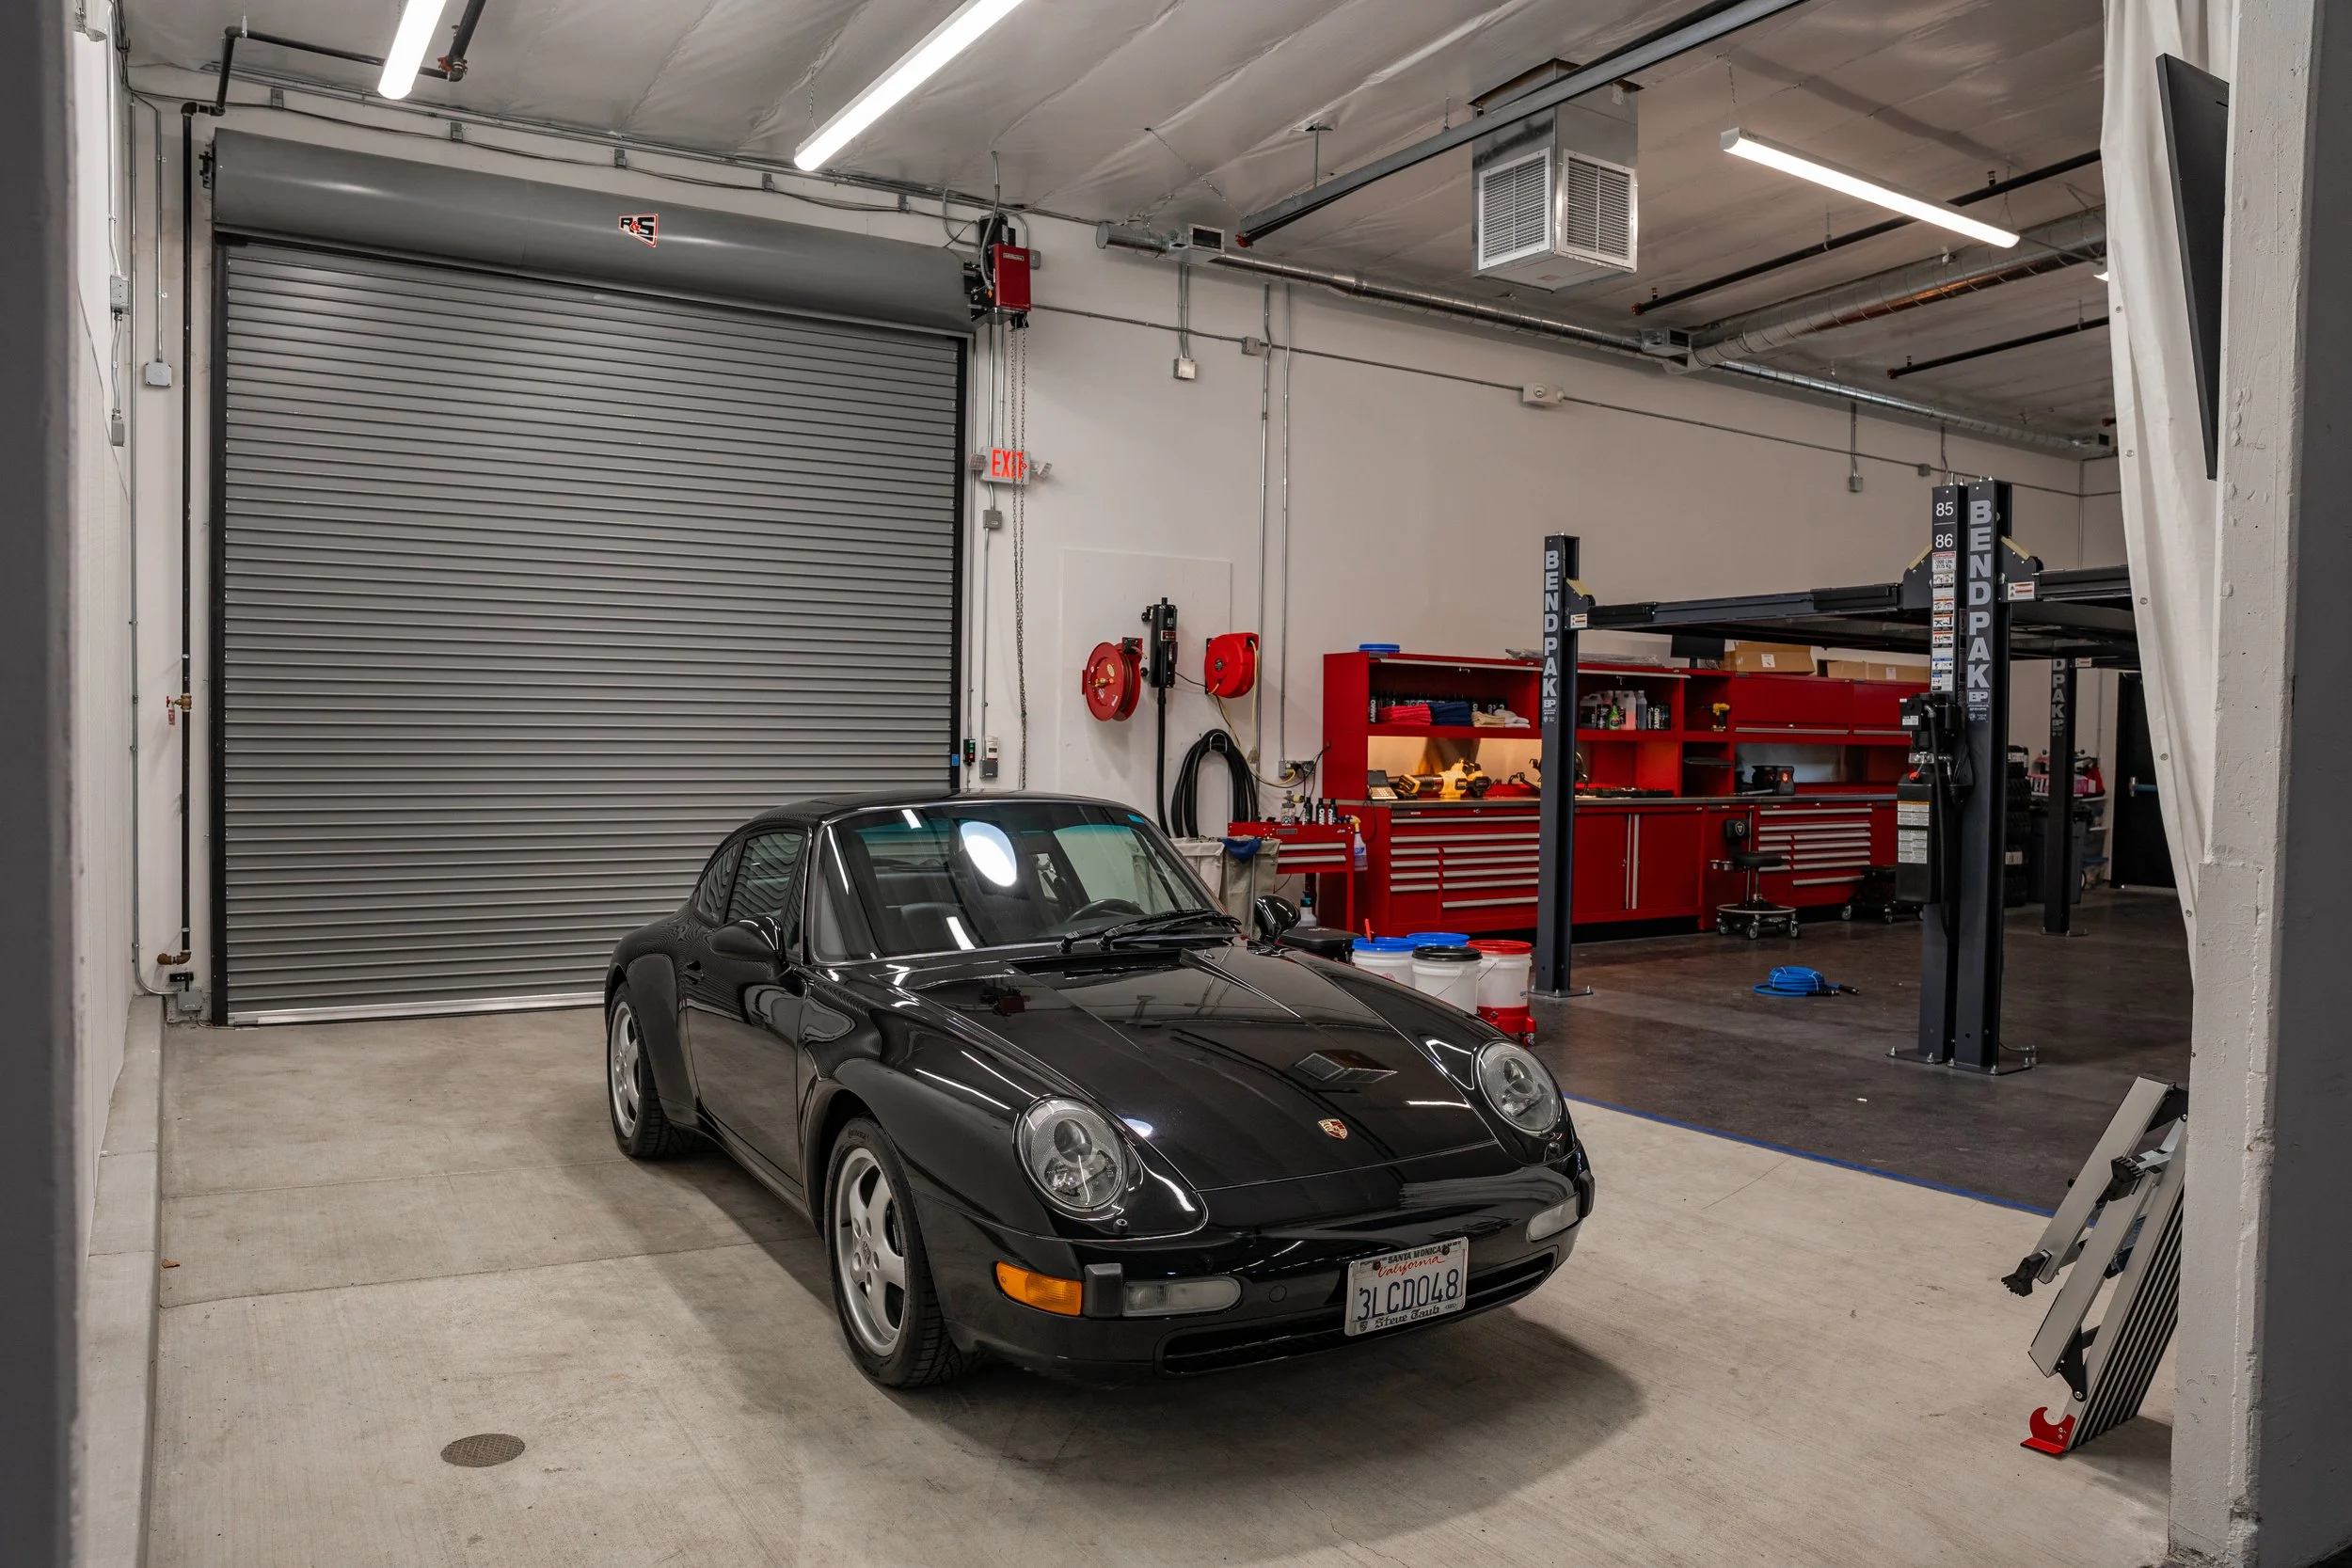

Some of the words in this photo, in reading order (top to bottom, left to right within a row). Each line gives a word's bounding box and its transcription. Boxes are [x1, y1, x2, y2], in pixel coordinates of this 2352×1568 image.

[992, 449, 1024, 479] EXIT
[1935, 501, 1954, 516] 85
[1935, 533, 1953, 548] 86
[1967, 499, 1993, 688] BENDPAK
[1543, 550, 1559, 697] BENDPAK
[2051, 657, 2067, 719] DPAK
[1377, 1255, 1445, 1278] California
[1388, 1253, 1412, 1264] SANTA
[1414, 1245, 1442, 1258] MONICA
